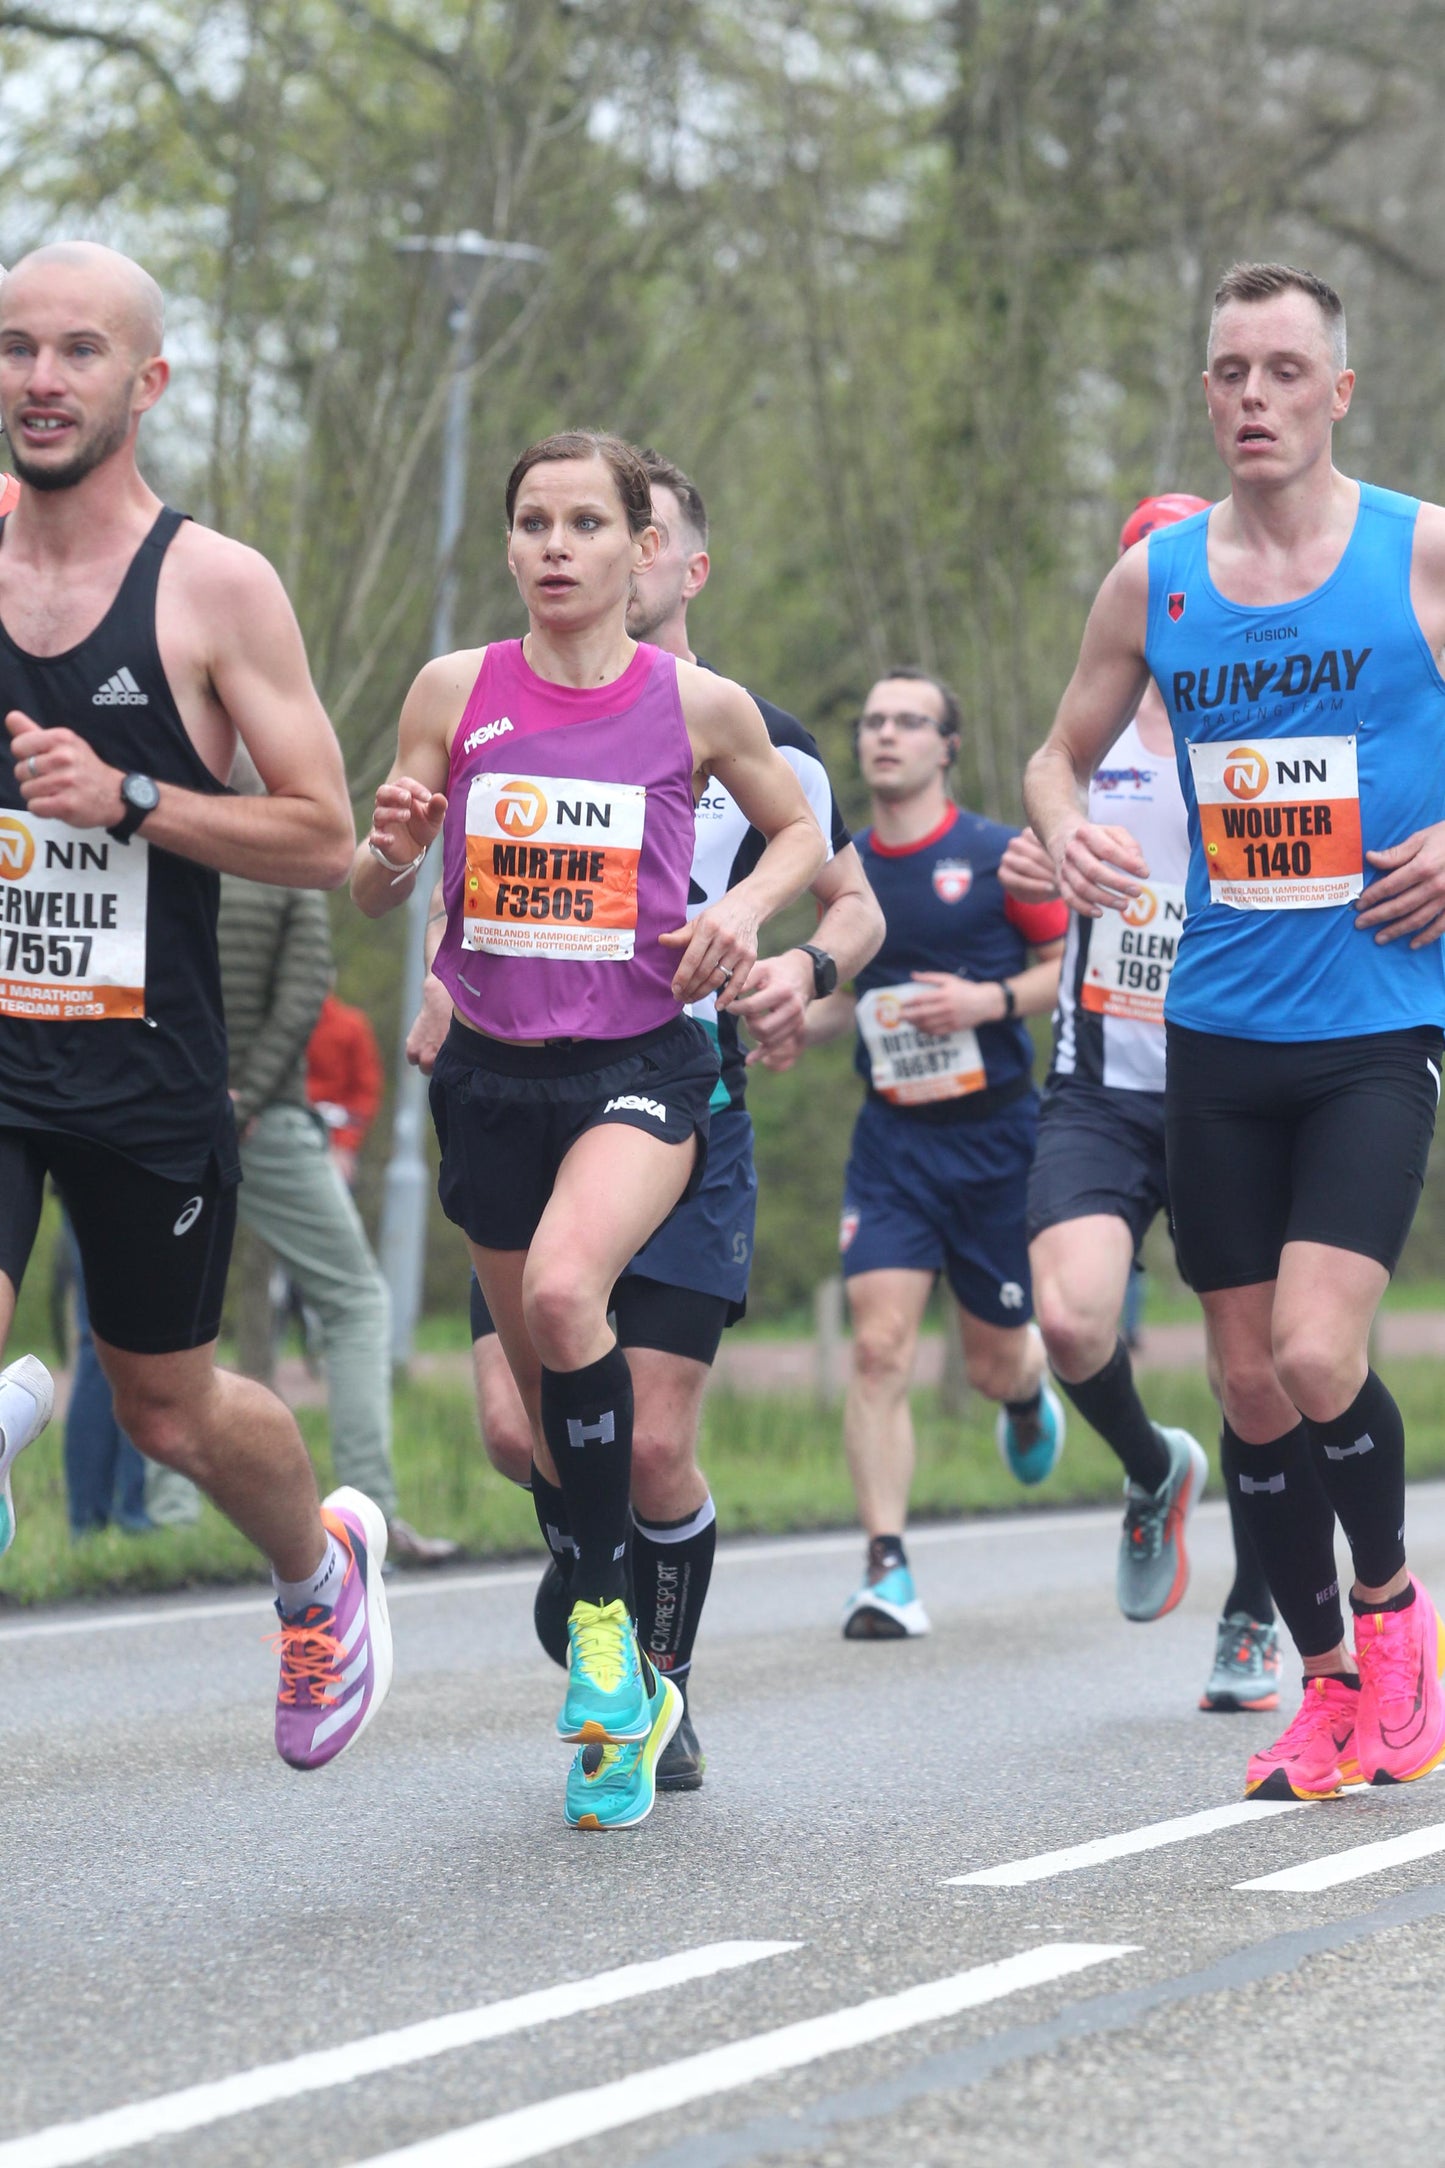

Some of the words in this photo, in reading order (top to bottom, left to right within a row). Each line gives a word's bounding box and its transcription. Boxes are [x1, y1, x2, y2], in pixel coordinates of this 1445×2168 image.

[1245, 626, 1298, 643] FUSION
[1173, 648, 1373, 713] RUN2DAY
[92, 690, 149, 706] adidas
[463, 716, 514, 755] HOKA
[1276, 759, 1327, 785] NN
[556, 800, 611, 828] NN
[1222, 805, 1332, 839] WOUTER
[45, 840, 108, 871] NN
[493, 844, 605, 883] MIRTHE
[1243, 841, 1312, 878] 1140
[1272, 882, 1350, 894] KAMPIOENSCHAP
[1275, 893, 1325, 903] ROTTERDAM
[0, 885, 118, 929] RVELLE
[495, 884, 594, 922] F3505
[473, 925, 530, 939] NEDERLANDS
[486, 937, 533, 949] MARATHON
[536, 941, 593, 952] ROTTERDAM
[1121, 930, 1174, 960] GLEN
[0, 928, 93, 977] 7557
[1117, 959, 1172, 992] 198
[9, 984, 94, 1002] MARATHON
[63, 1003, 105, 1016] 2023
[603, 1095, 666, 1123] HOKA
